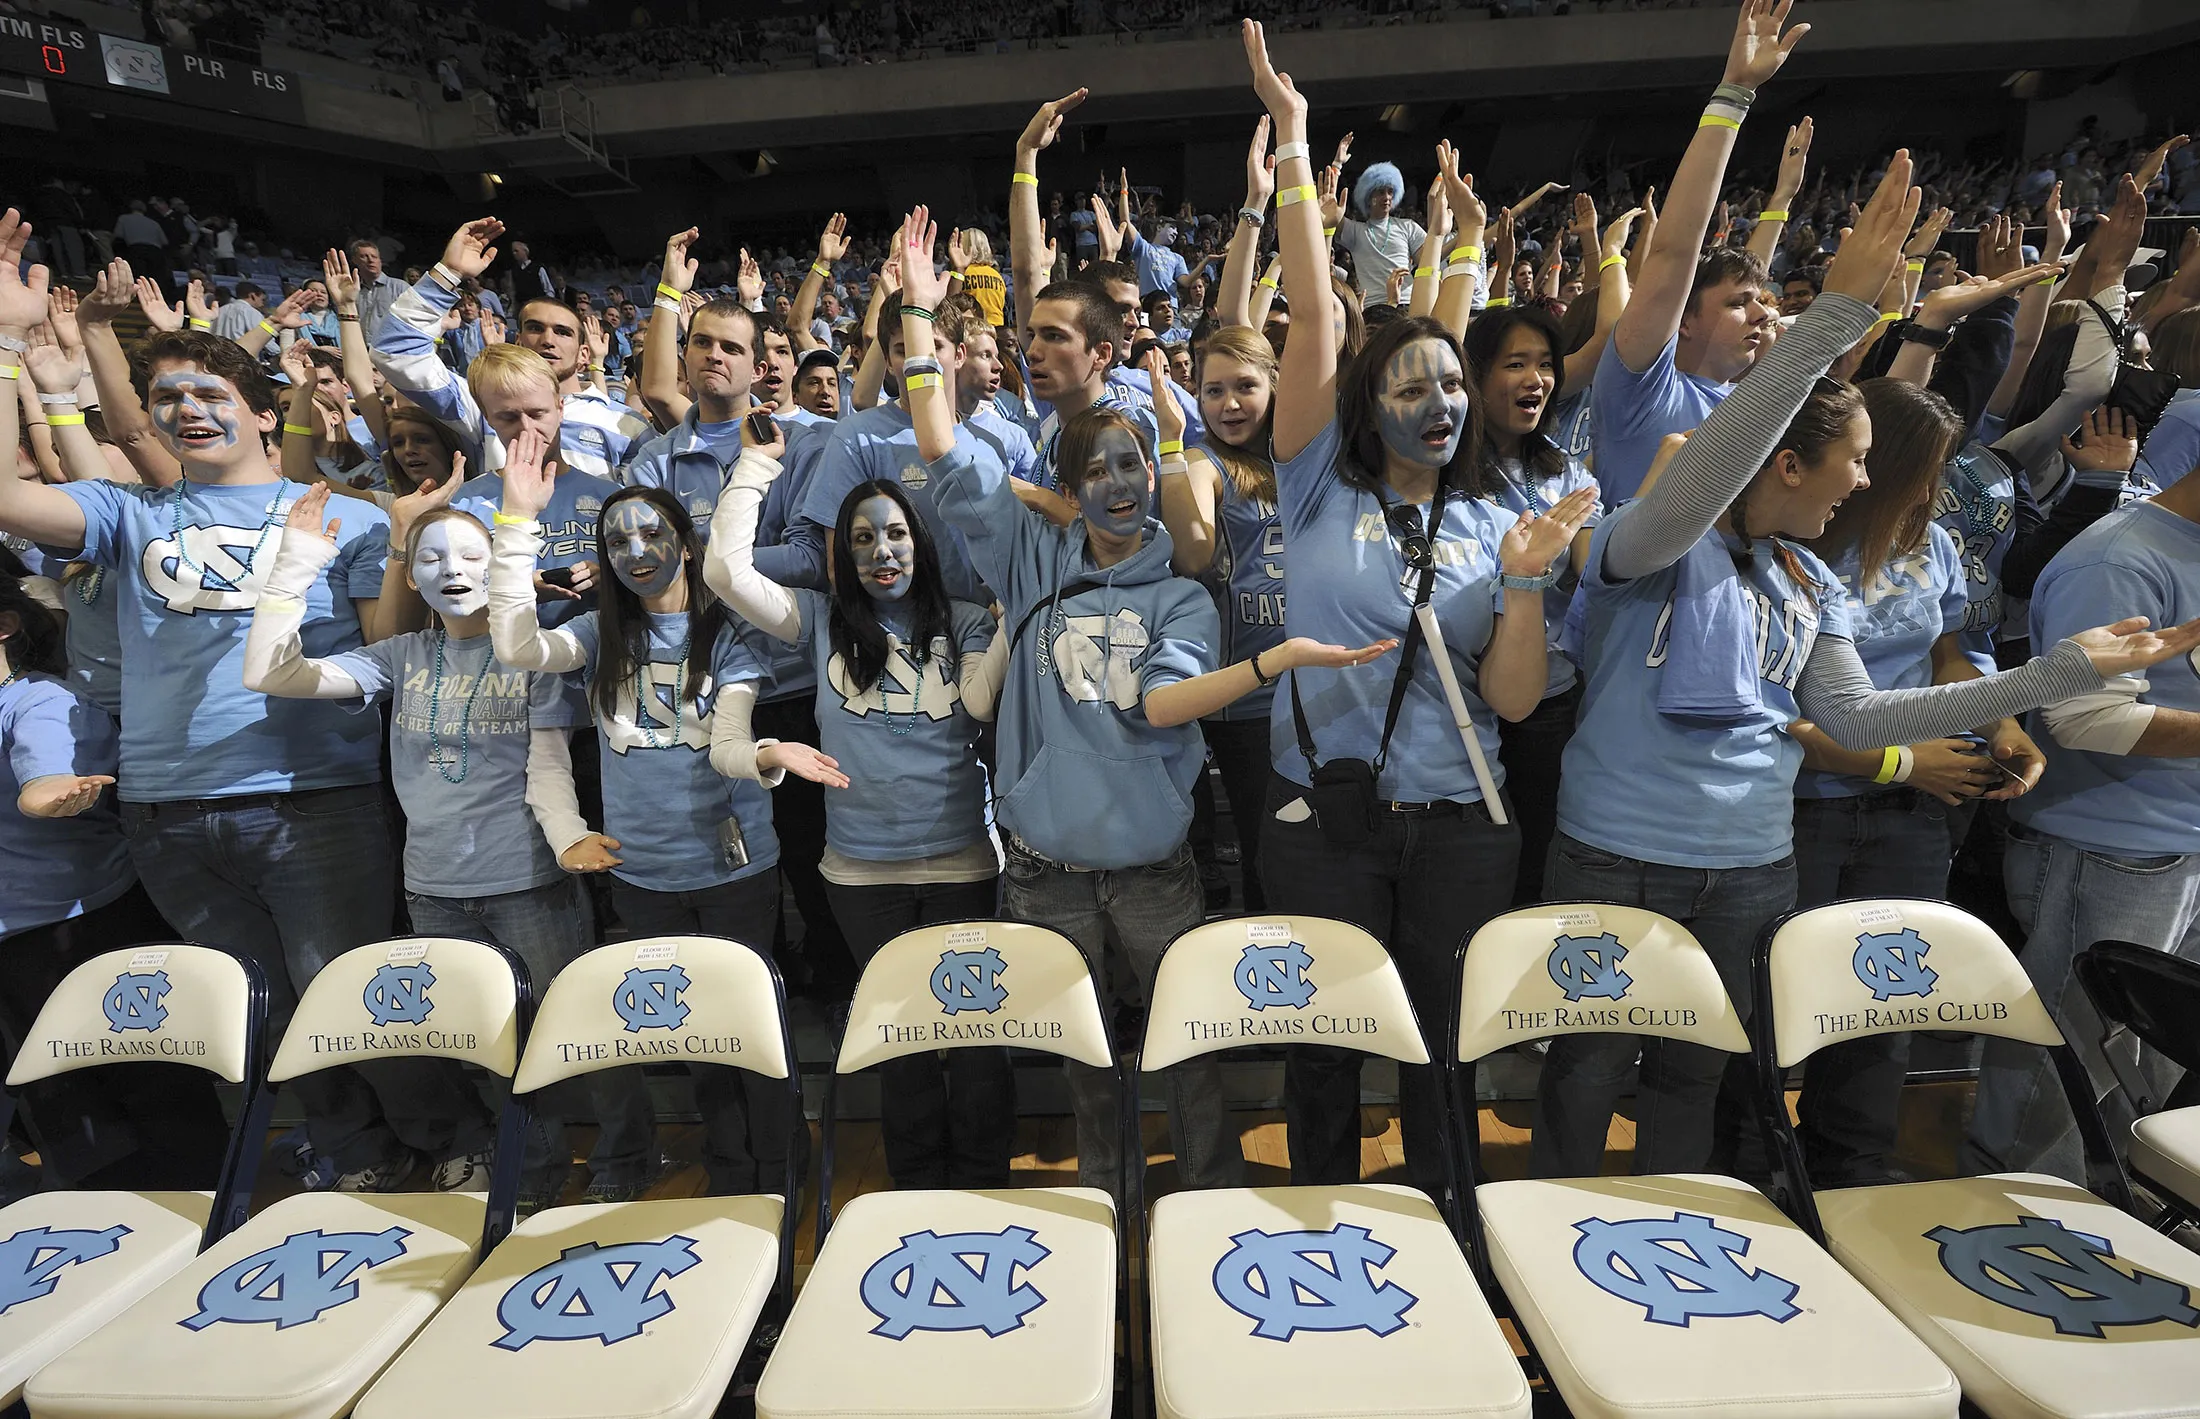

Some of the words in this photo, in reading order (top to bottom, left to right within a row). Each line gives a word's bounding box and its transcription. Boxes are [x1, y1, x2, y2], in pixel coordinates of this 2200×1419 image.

[40, 24, 86, 49] FLS
[42, 45, 65, 74] 0
[183, 54, 227, 80] PLR
[252, 70, 287, 92] FLS
[443, 722, 462, 735] OF
[465, 723, 476, 734] A
[479, 720, 528, 734] TEAM
[1185, 1021, 1233, 1040] THE
[1240, 1017, 1304, 1036] RAMS
[1312, 1014, 1377, 1034] CLUB
[1501, 1010, 1548, 1030] THE
[1554, 1008, 1619, 1028] RAMS
[1628, 1006, 1697, 1027] CLUB
[1814, 1014, 1858, 1035] THE
[1864, 1007, 1929, 1029] RAMS
[1937, 1001, 2008, 1022] CLUB
[309, 1035, 357, 1053] THE
[363, 1032, 421, 1050] RAMS
[426, 1031, 477, 1050] CLUB
[878, 1025, 927, 1043] THE
[932, 1021, 996, 1039] RAMS
[1002, 1019, 1062, 1039] CLUB
[47, 1040, 94, 1057] THE
[100, 1038, 156, 1056] RAMS
[160, 1038, 206, 1056] CLUB
[557, 1043, 609, 1062] THE
[615, 1039, 678, 1057] RAMS
[684, 1035, 742, 1054] CLUB
